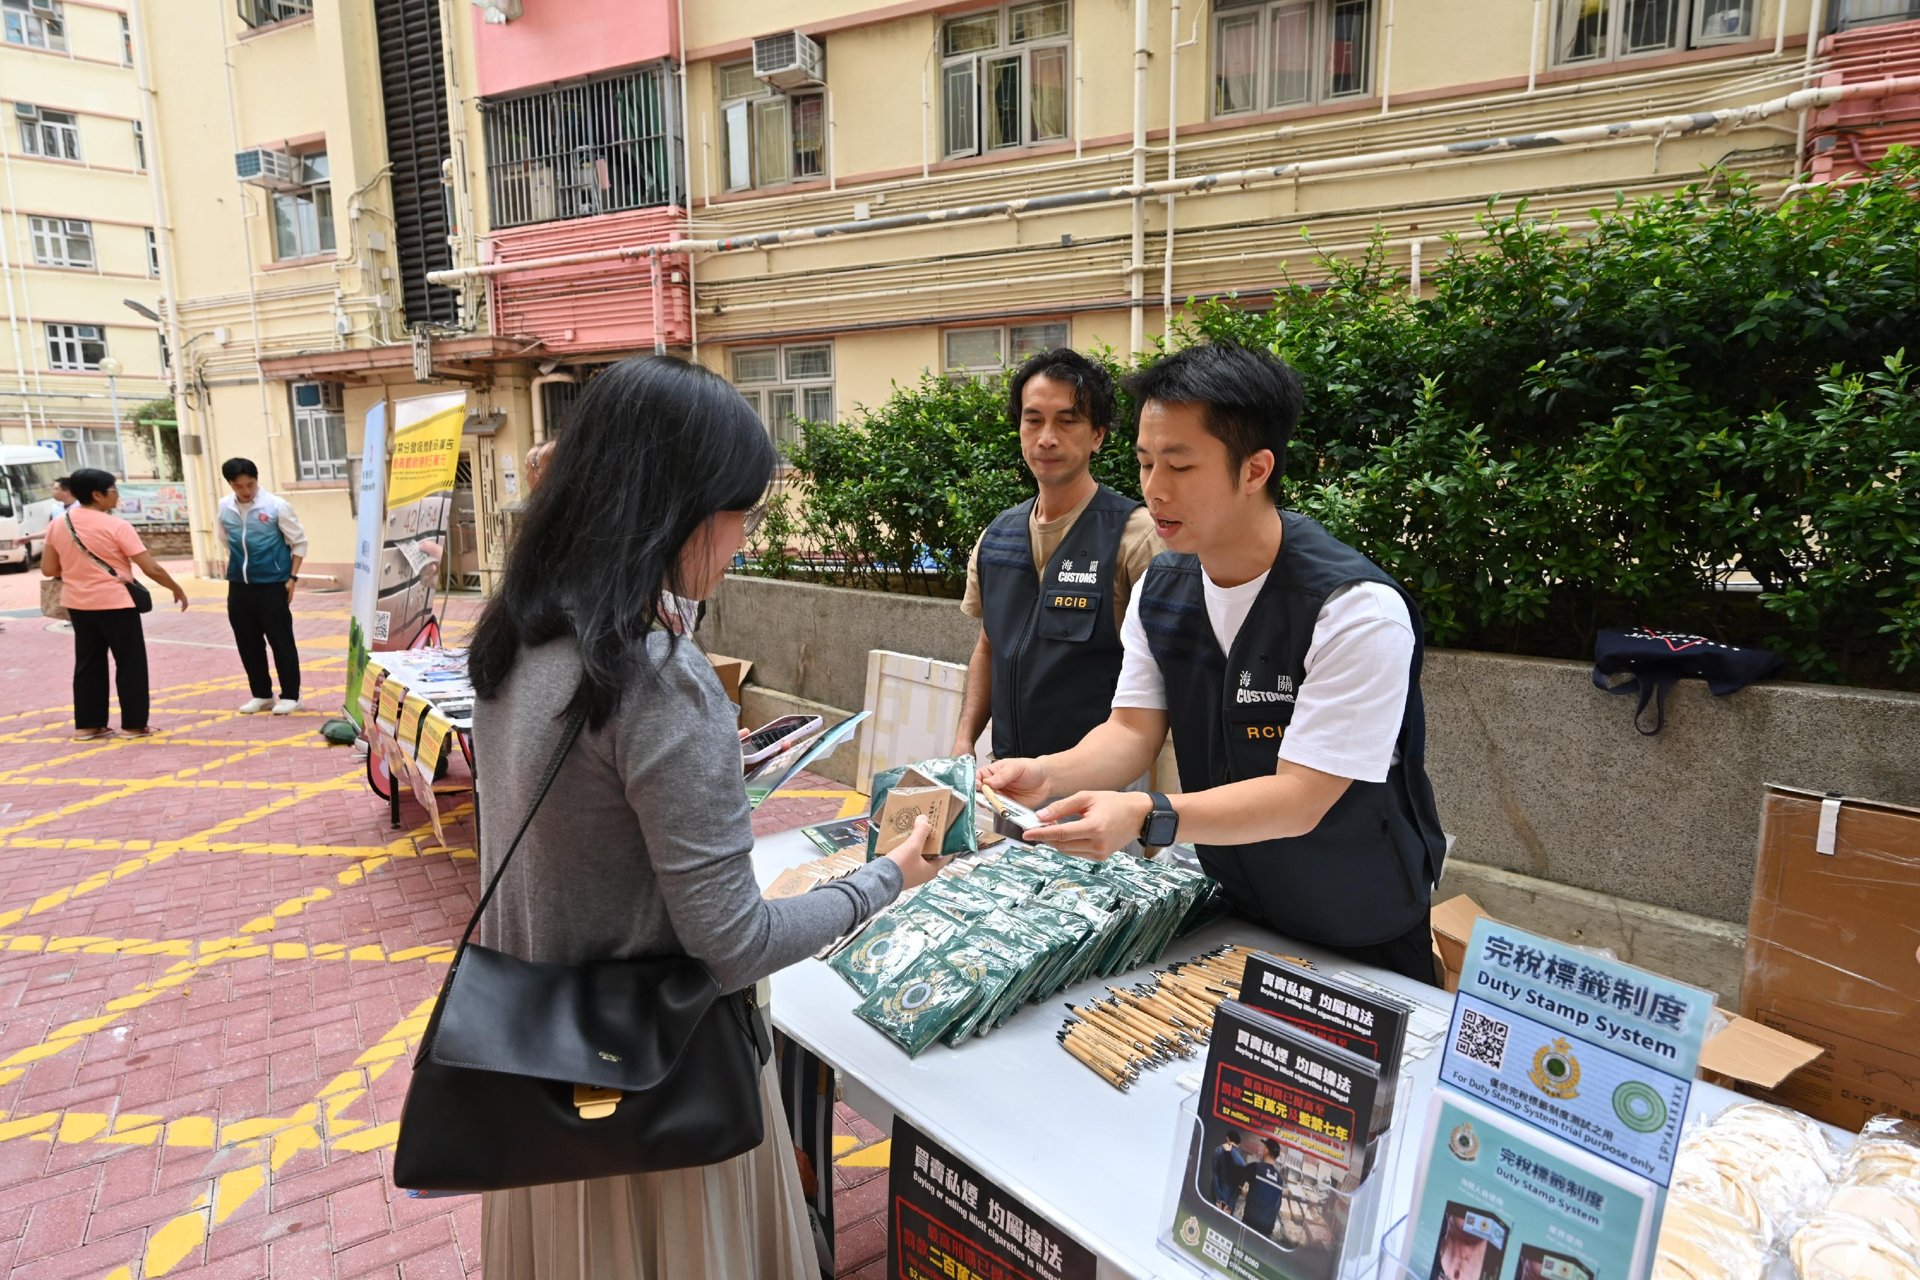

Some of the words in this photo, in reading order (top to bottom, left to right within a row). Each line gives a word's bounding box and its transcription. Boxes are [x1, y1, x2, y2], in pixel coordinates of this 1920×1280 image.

[404, 509, 417, 533] 42
[1054, 596, 1087, 608] RCIB
[1057, 571, 1097, 584] CUSTOMS
[1236, 688, 1296, 704] CUSTOMS
[1240, 671, 1252, 687] 海
[1247, 725, 1283, 739] RCI
[1483, 935, 1688, 1031] 完稅標籤制度
[1477, 970, 1521, 1001] Duty
[1526, 989, 1589, 1026] Stamp
[1595, 1015, 1677, 1059] System
[1235, 1045, 1254, 1059] Buying
[1329, 1089, 1349, 1103] illegal
[1237, 1029, 1289, 1065] 買賣私煙
[1295, 1056, 1352, 1094] 均屬違法
[1453, 1071, 1467, 1083] For
[1468, 1078, 1490, 1095] Duty
[1491, 1090, 1521, 1109] Stamp
[1523, 1105, 1559, 1127] System
[1561, 1121, 1584, 1138] trial
[1584, 1134, 1629, 1160] purpose
[1630, 1154, 1655, 1174] only
[913, 1170, 936, 1195] Buying
[936, 1189, 944, 1200] or
[945, 1196, 967, 1219] selling
[968, 1211, 987, 1233] illicit
[988, 1228, 1025, 1261] cigarettes
[1027, 1255, 1034, 1268] is
[914, 1145, 979, 1210] 買賣私煙
[987, 1198, 1063, 1273] 均屬違法
[1496, 1166, 1520, 1185] Duty
[1522, 1178, 1555, 1203] Stamp
[1558, 1199, 1599, 1225] System
